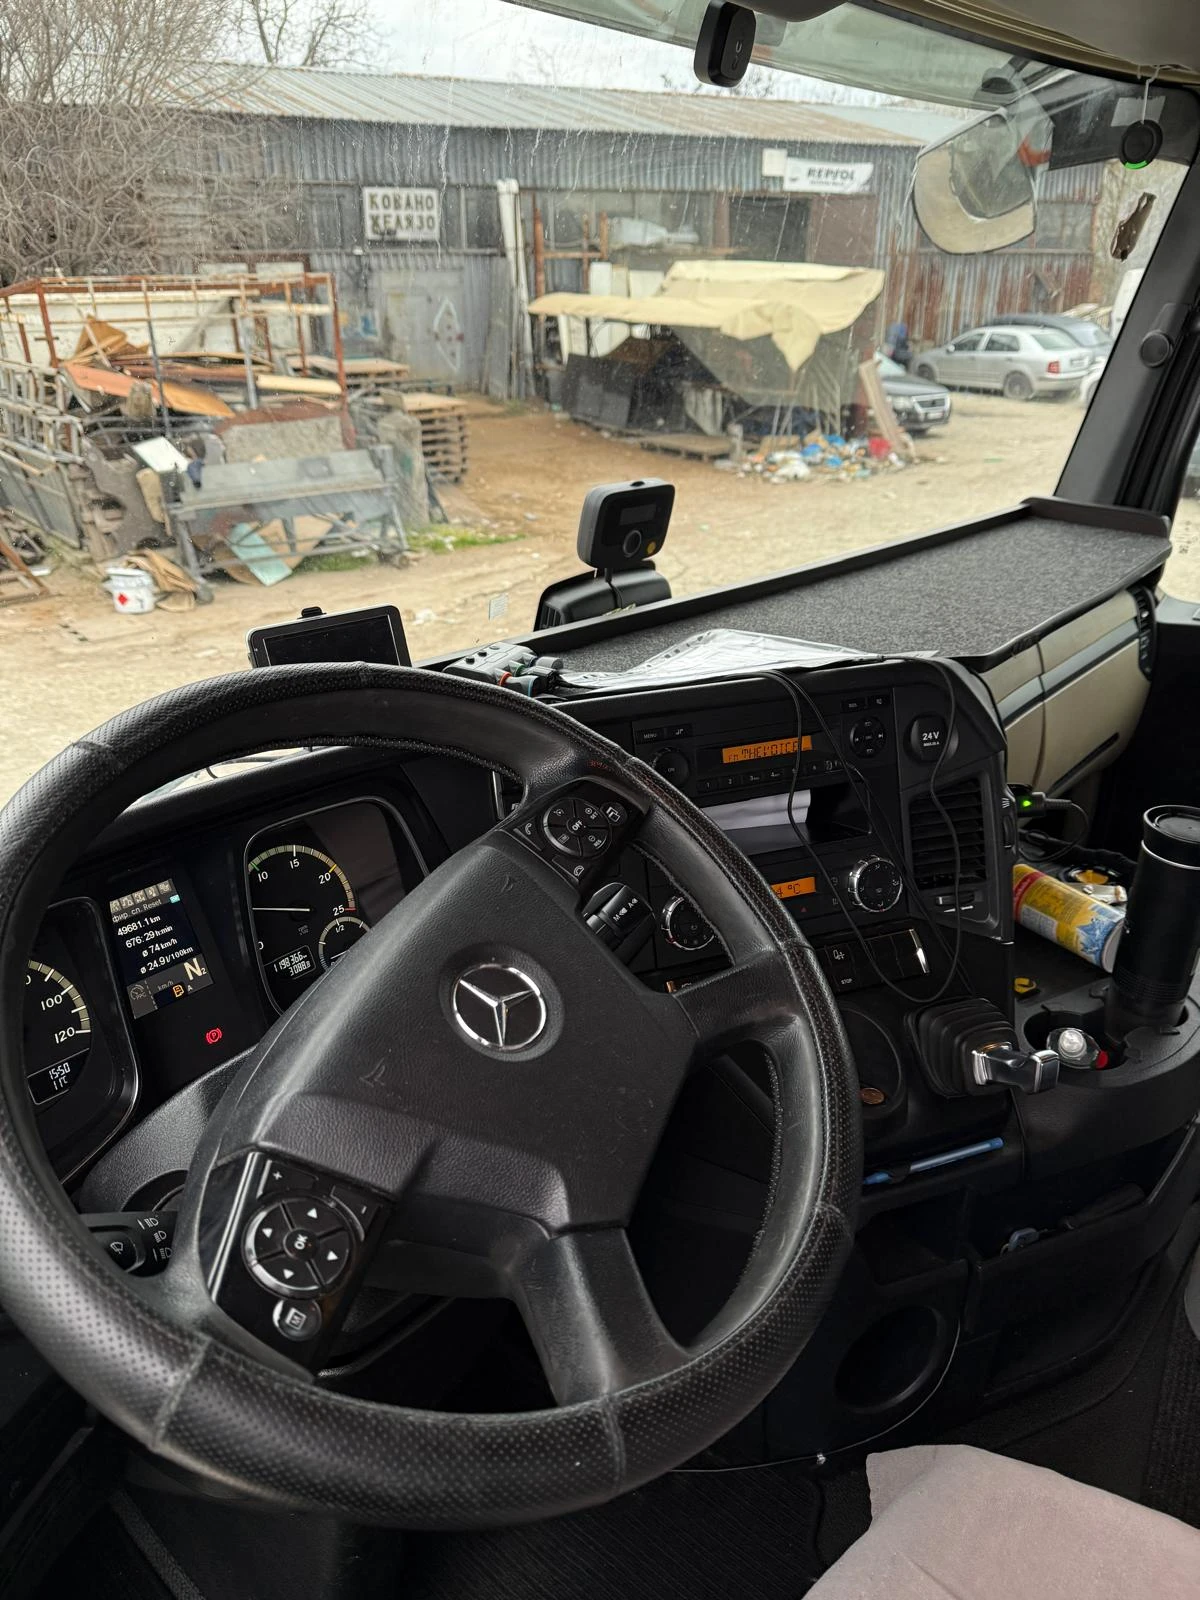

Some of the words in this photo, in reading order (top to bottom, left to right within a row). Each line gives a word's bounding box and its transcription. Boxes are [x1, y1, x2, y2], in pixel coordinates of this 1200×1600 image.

[369, 193, 434, 211] КОВАНО
[370, 213, 435, 234] ЖЕЛЯЗО
[289, 858, 300, 870] 15
[257, 871, 269, 882] 10
[318, 872, 331, 884] 20
[143, 899, 162, 910] Reset
[332, 904, 345, 916] 25
[117, 917, 150, 936] 49681.1
[125, 930, 155, 948] 676:29
[40, 994, 63, 1011] 100
[54, 1026, 75, 1044] 120
[49, 1062, 71, 1080] 15:50
[294, 1234, 308, 1250] OK
